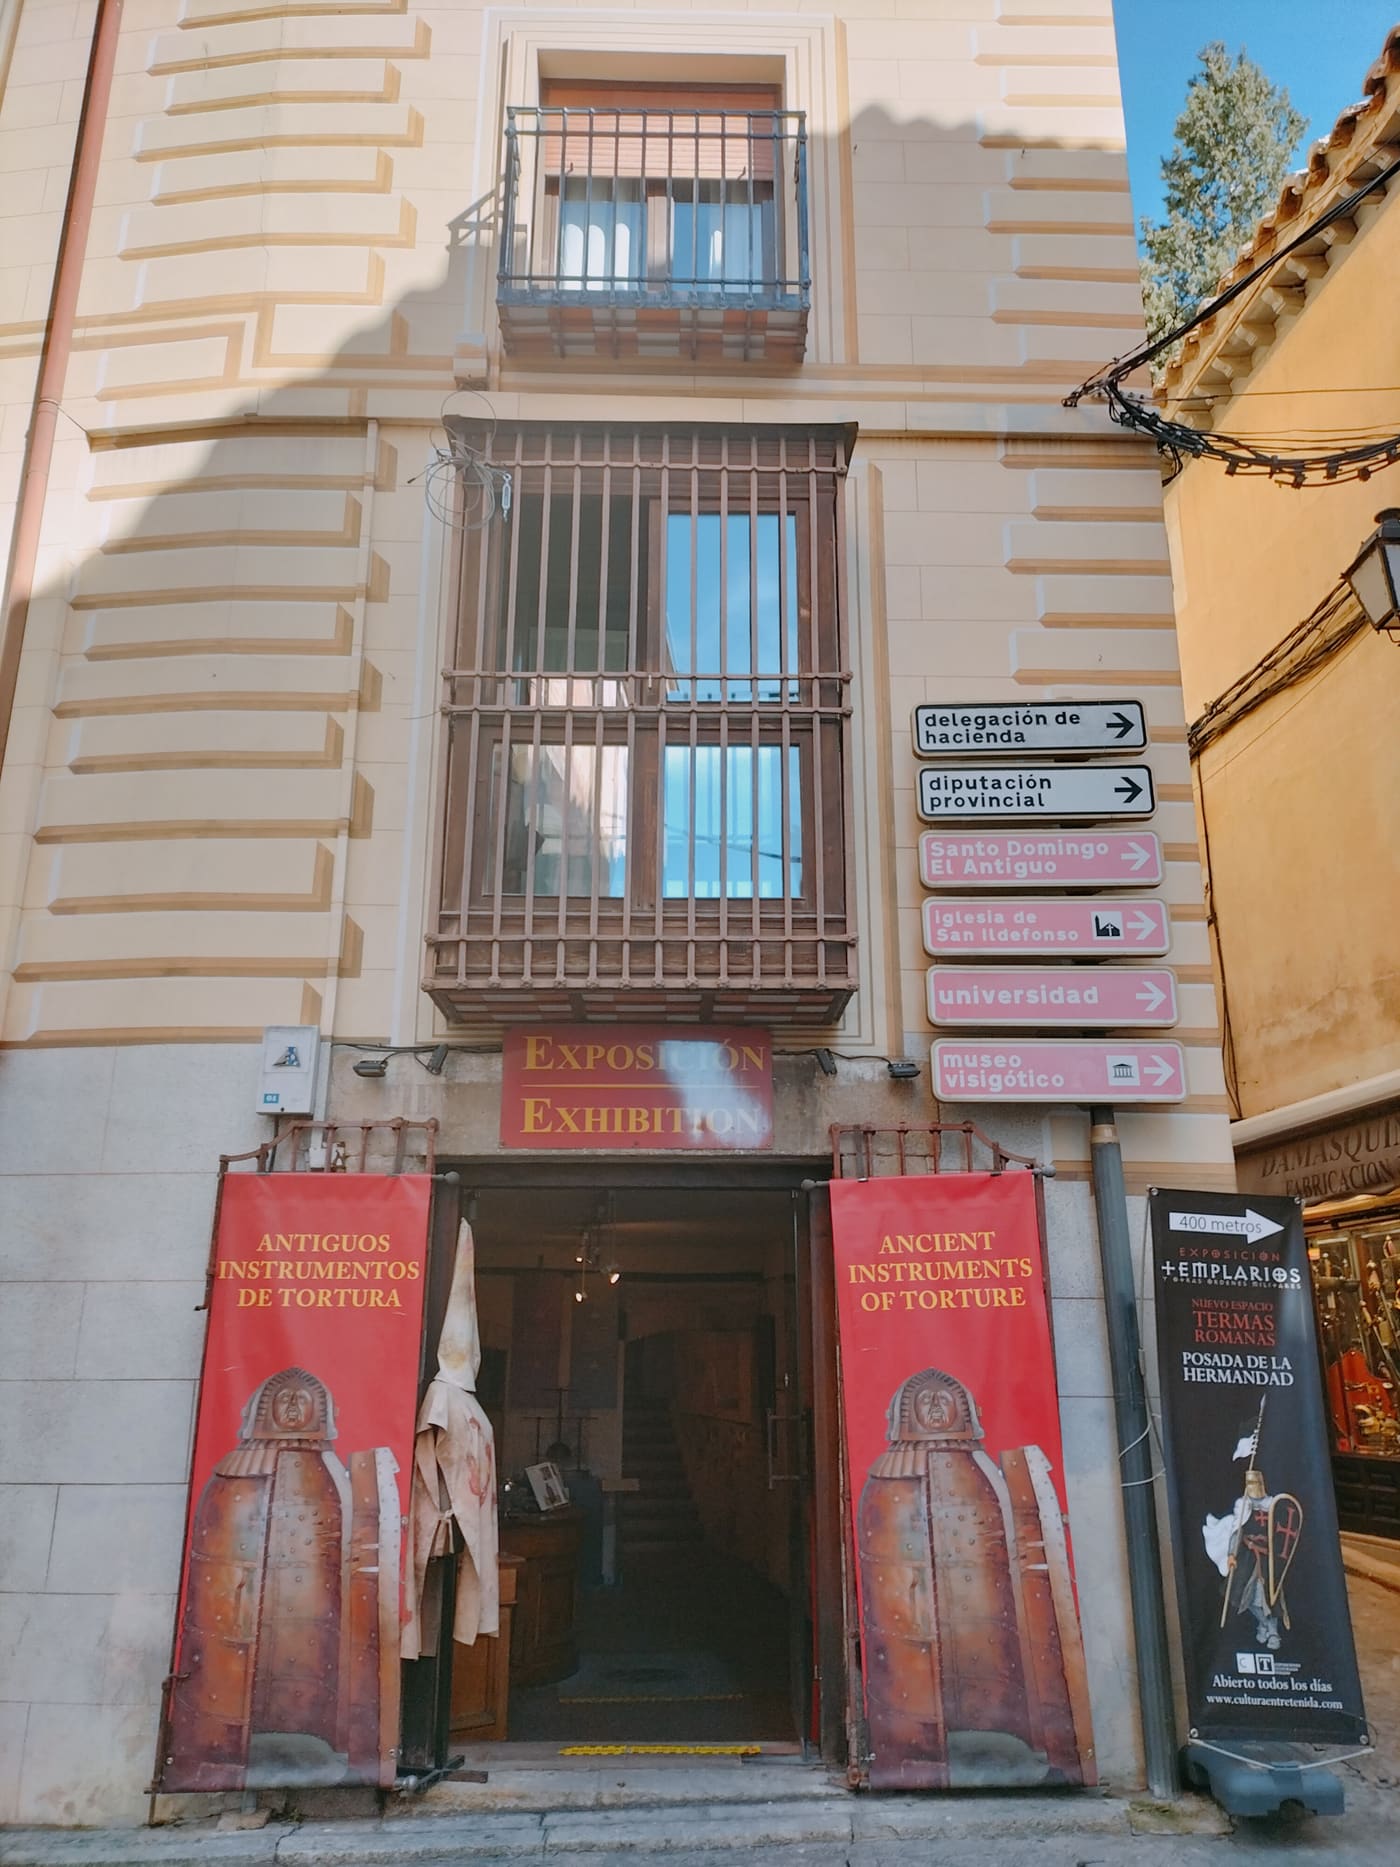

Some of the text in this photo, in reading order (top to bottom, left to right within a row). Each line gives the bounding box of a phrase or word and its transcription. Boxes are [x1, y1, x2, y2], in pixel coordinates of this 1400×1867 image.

[925, 710, 1081, 730] delegación de
[925, 729, 1026, 744] hacienda
[929, 774, 1052, 794] diputación
[930, 793, 1045, 811] provincial
[930, 840, 1109, 860] Santo Domingo
[930, 857, 1057, 879] El Antiguo
[1013, 911, 1037, 924] de
[936, 927, 1079, 943] San Ildefonso
[938, 985, 1099, 1005] universidad
[943, 1053, 1022, 1068] museo
[945, 1069, 1065, 1092] visigótico
[520, 1098, 760, 1134] EXHIBITION
[1179, 1215, 1263, 1234] 400 metros
[256, 1233, 391, 1253] ANTIGUOS
[878, 1231, 996, 1255] ANCIENT
[218, 1260, 421, 1281] INSTRUMENTOS
[848, 1257, 1033, 1284] INSTRUMENTS
[237, 1288, 402, 1309] DE TORTURA
[861, 1287, 1026, 1312] OF TORTURE
[1191, 1298, 1274, 1312] NUEVO ESPACIO
[1192, 1310, 1275, 1331] TERMAS
[1194, 1328, 1276, 1347] ROMANAS
[1182, 1351, 1293, 1371] POSADA DE LA
[1183, 1366, 1295, 1387] HERMANDAD
[1212, 1674, 1333, 1693] Abierto todos los días
[1206, 1692, 1343, 1710] www.culturaentretenida.com
